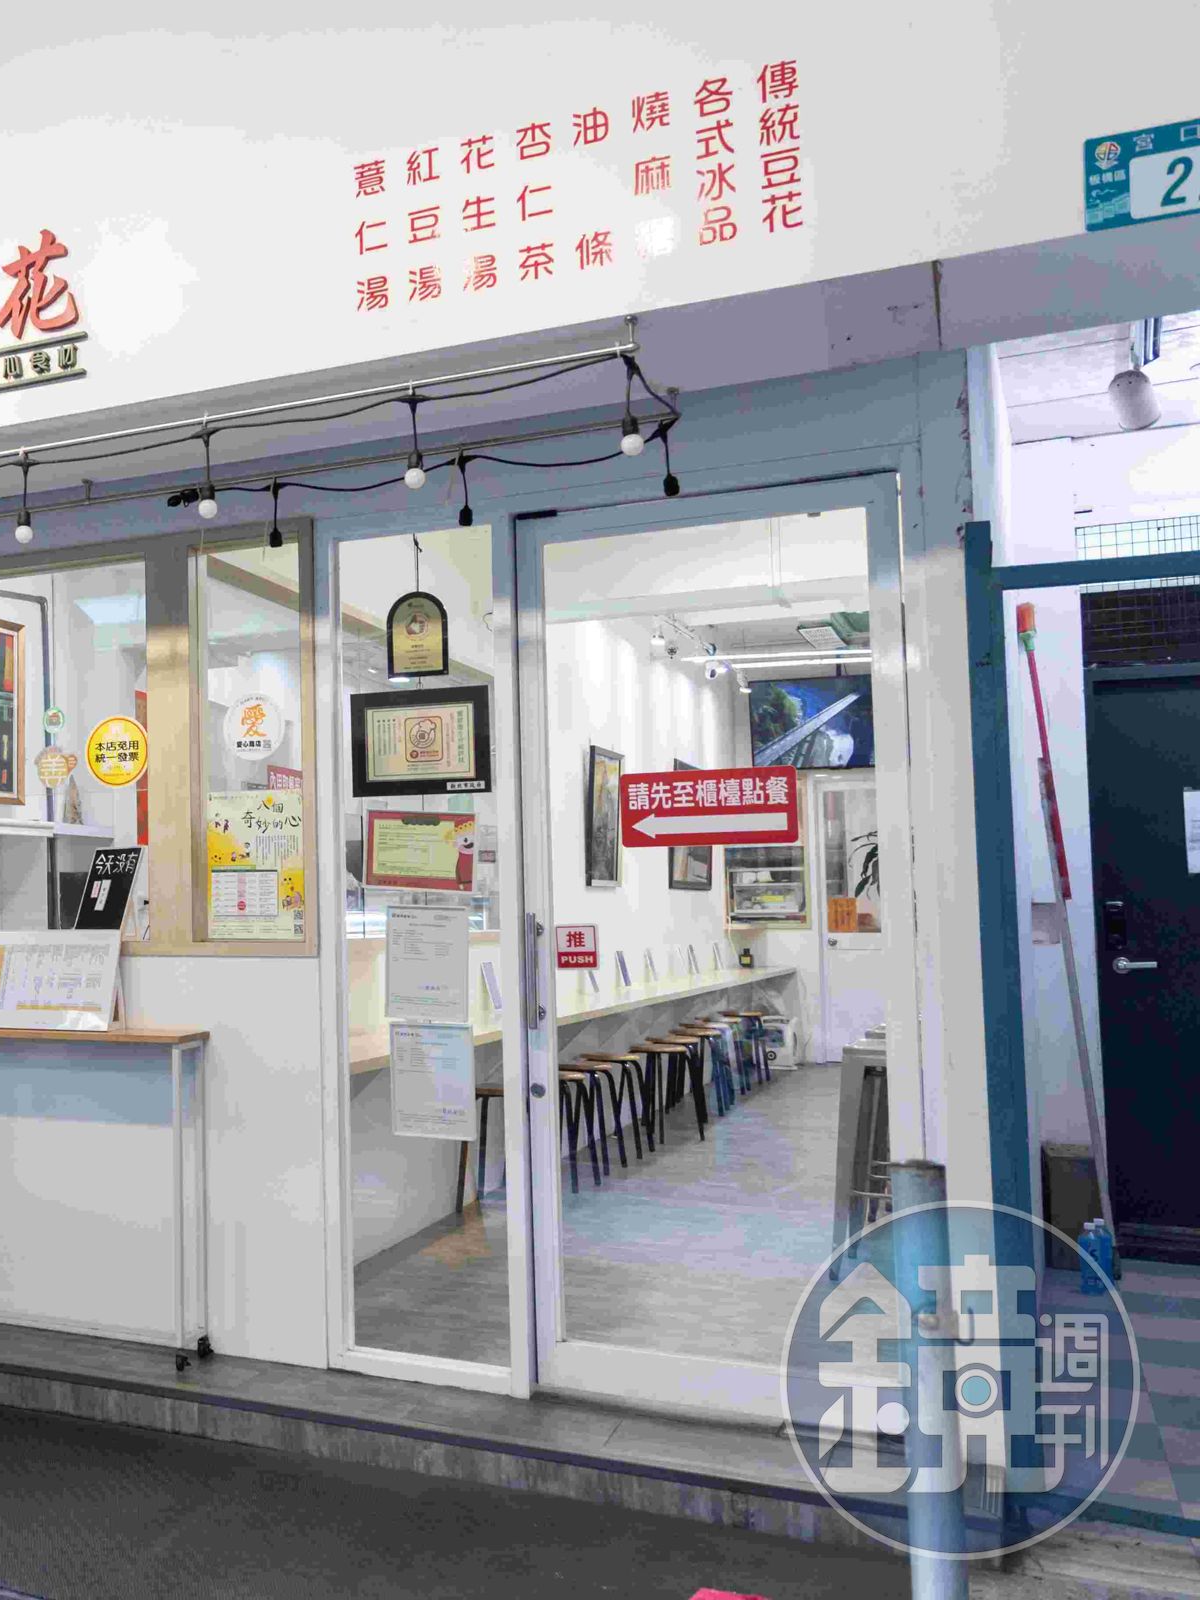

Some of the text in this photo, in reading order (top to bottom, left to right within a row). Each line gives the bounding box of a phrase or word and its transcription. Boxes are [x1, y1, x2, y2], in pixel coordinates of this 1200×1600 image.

[460, 135, 497, 292] 花生湯
[516, 121, 555, 282] 杏仁茶
[572, 106, 613, 269] 油條
[632, 91, 676, 261] 燒麻
[694, 77, 737, 247] 各式冰品
[757, 60, 803, 233] 傳統豆花
[1160, 156, 1200, 207] 2
[353, 159, 389, 312] 薏仁湯
[406, 147, 442, 304] 紅豆湯
[95, 740, 139, 752] 本店免用
[95, 752, 140, 763] 統一發票
[628, 776, 789, 811] 請先至櫃檯點餐
[95, 851, 139, 875] 今天沒有
[566, 931, 585, 947] 推
[561, 955, 594, 964] PUSH
